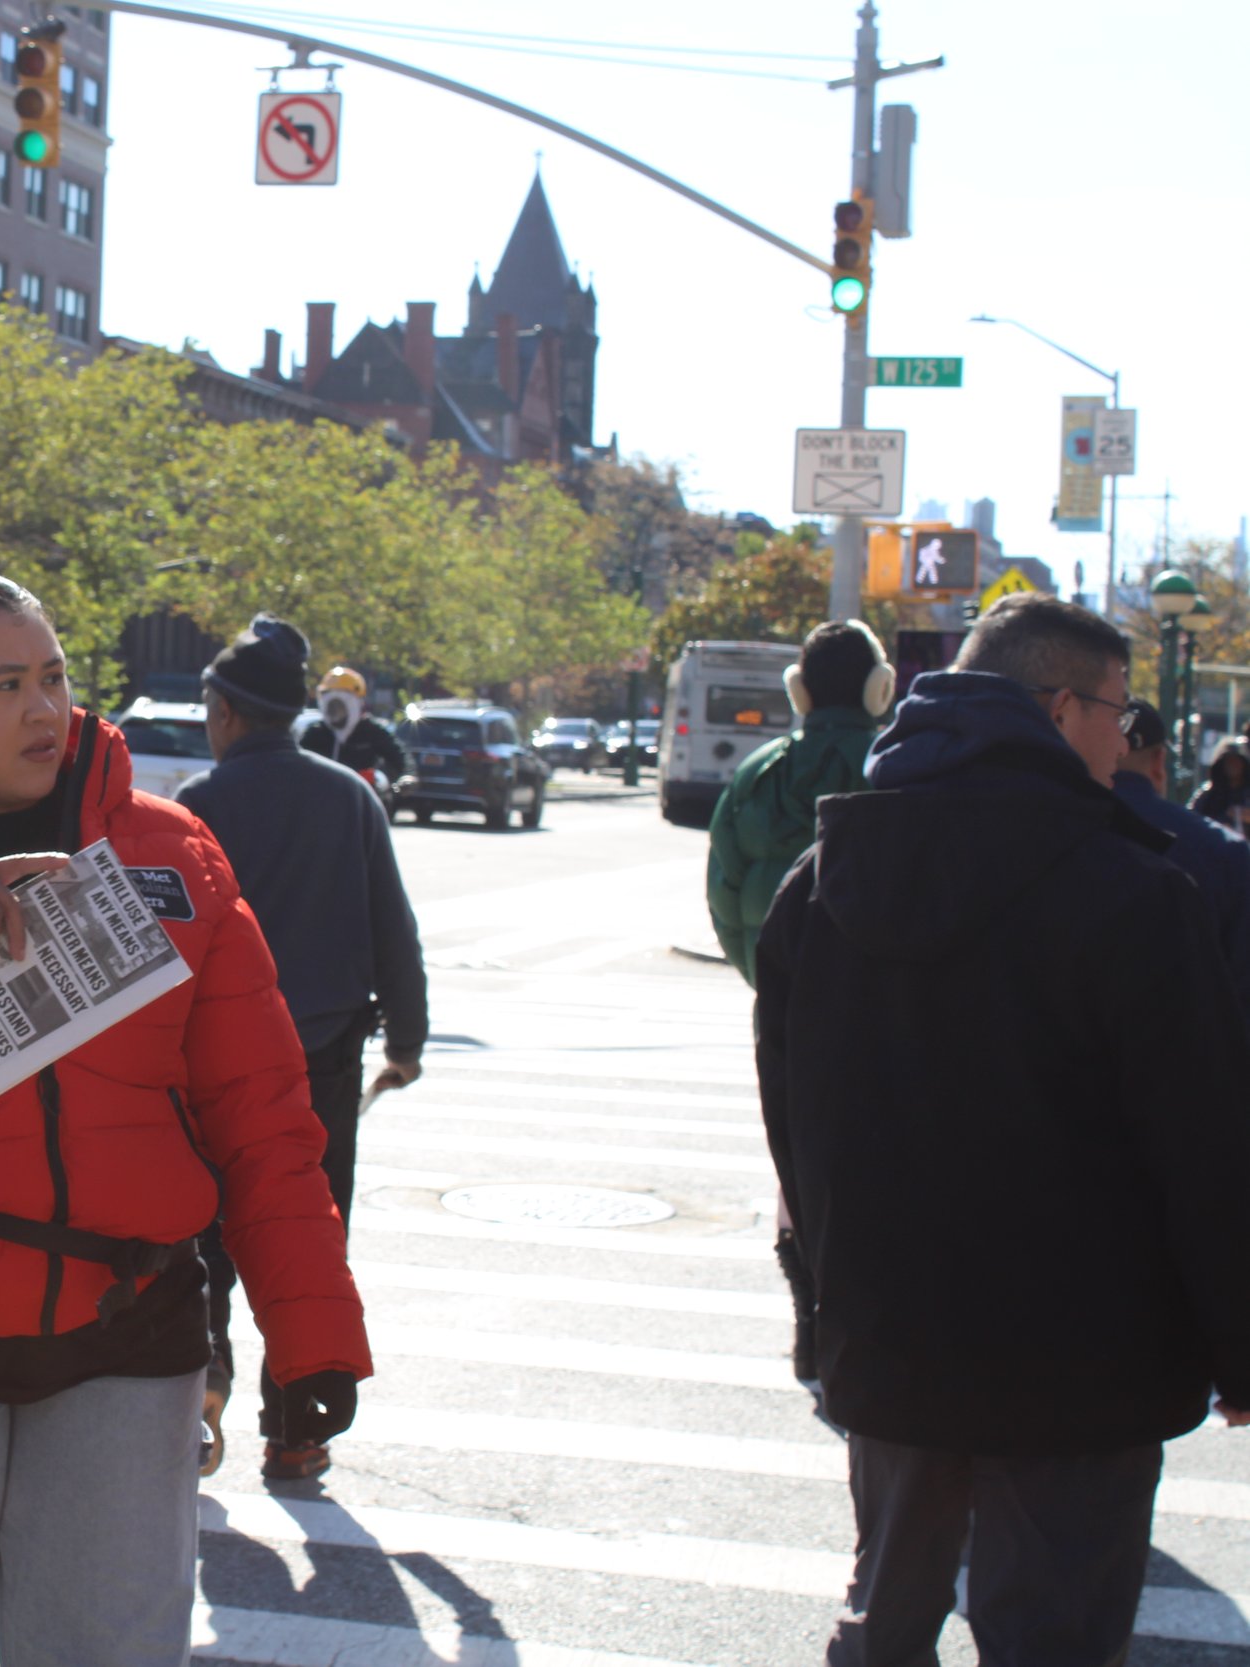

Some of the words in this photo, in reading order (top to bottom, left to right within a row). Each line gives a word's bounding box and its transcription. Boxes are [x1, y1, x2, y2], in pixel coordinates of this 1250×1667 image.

[882, 360, 899, 384] W
[904, 360, 939, 385] 125
[802, 434, 845, 450] DON'T
[850, 434, 896, 450] BLOCK
[1099, 434, 1132, 457] 25
[819, 455, 845, 469] THE
[852, 455, 879, 469] BOX
[94, 850, 114, 874] WE
[105, 870, 131, 904] WILL
[122, 900, 147, 927] USE
[140, 871, 172, 883] Met
[34, 884, 82, 951] WHATEVER
[72, 948, 107, 992] MEANS
[90, 890, 115, 915] ANY
[106, 913, 141, 957] MEANS
[36, 945, 89, 1015] NECESSARY
[0, 998, 32, 1039] STAND
